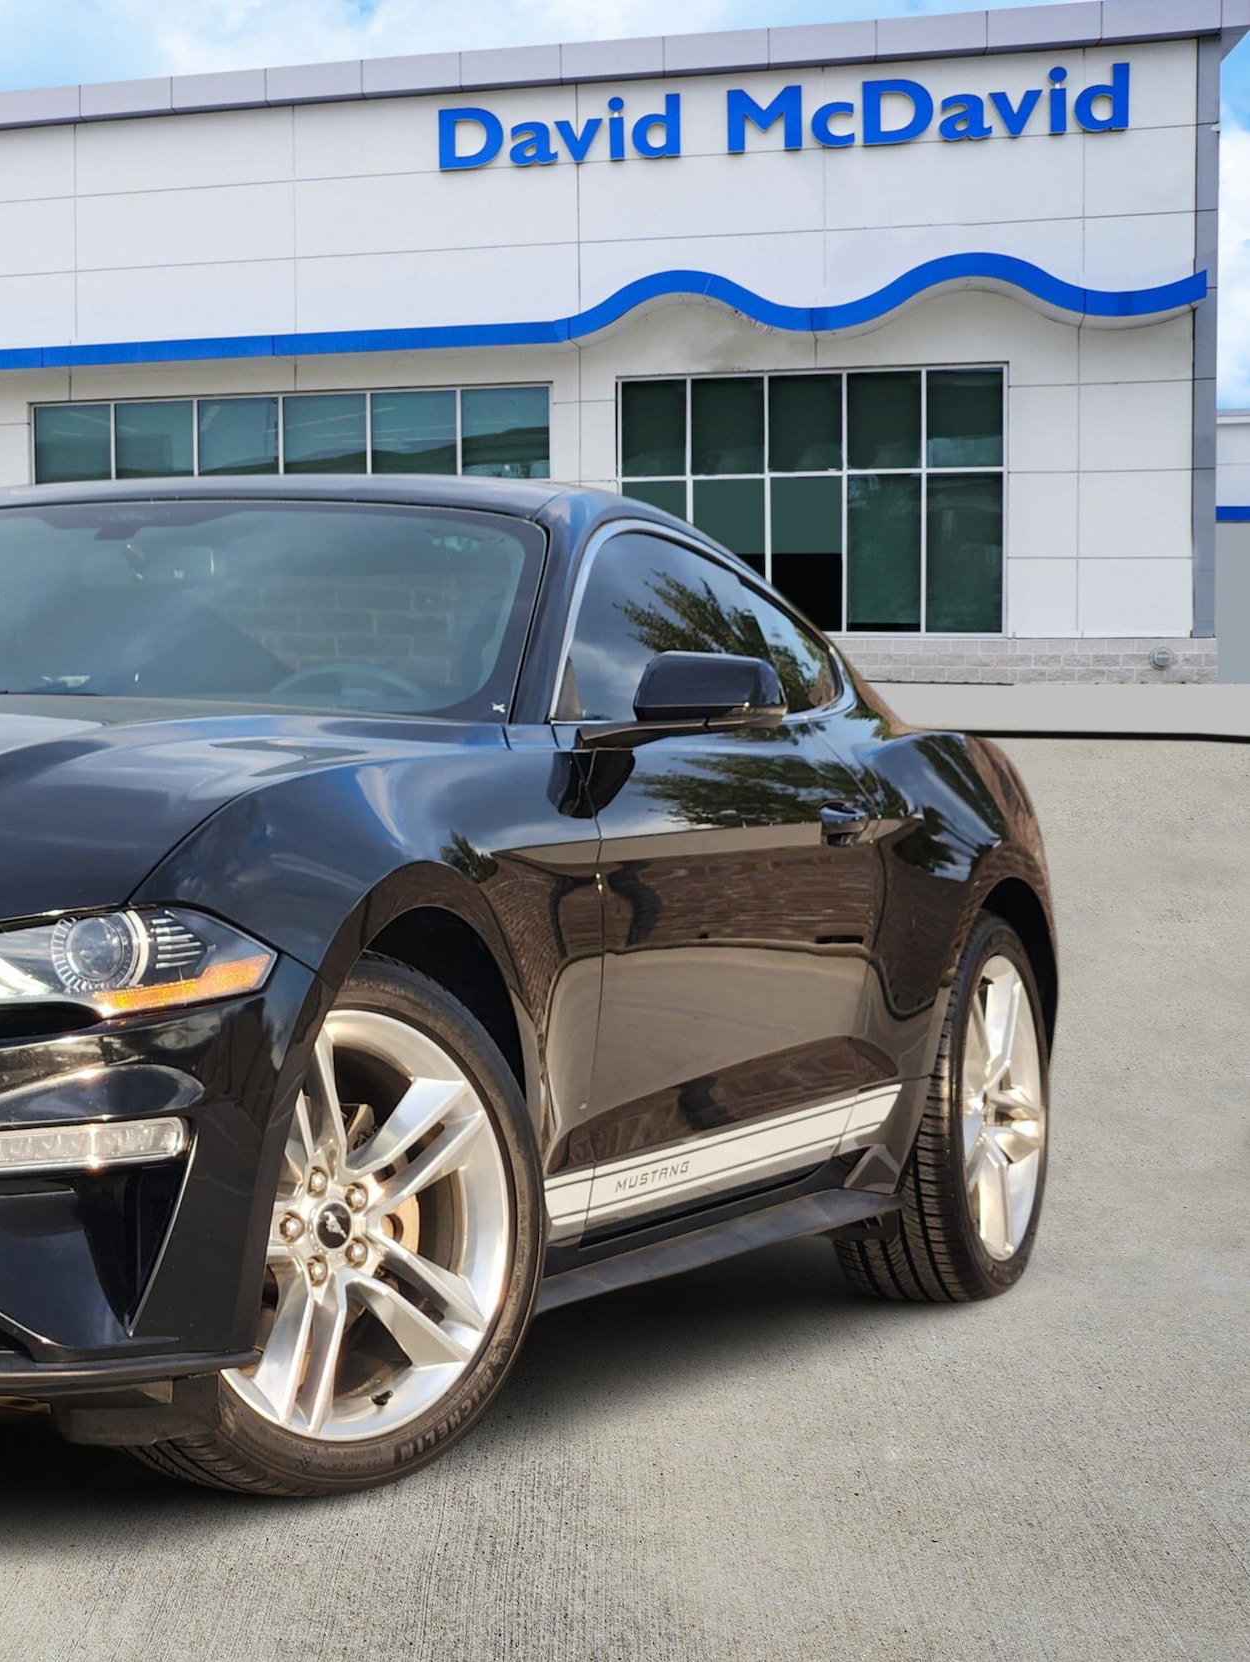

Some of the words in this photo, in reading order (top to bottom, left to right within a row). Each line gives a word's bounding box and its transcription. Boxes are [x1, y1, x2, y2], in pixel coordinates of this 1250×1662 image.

[438, 94, 681, 171] David
[726, 63, 1131, 152] McDavid
[614, 1160, 690, 1193] MUSTANG
[399, 1366, 495, 1462] MICHELIN
